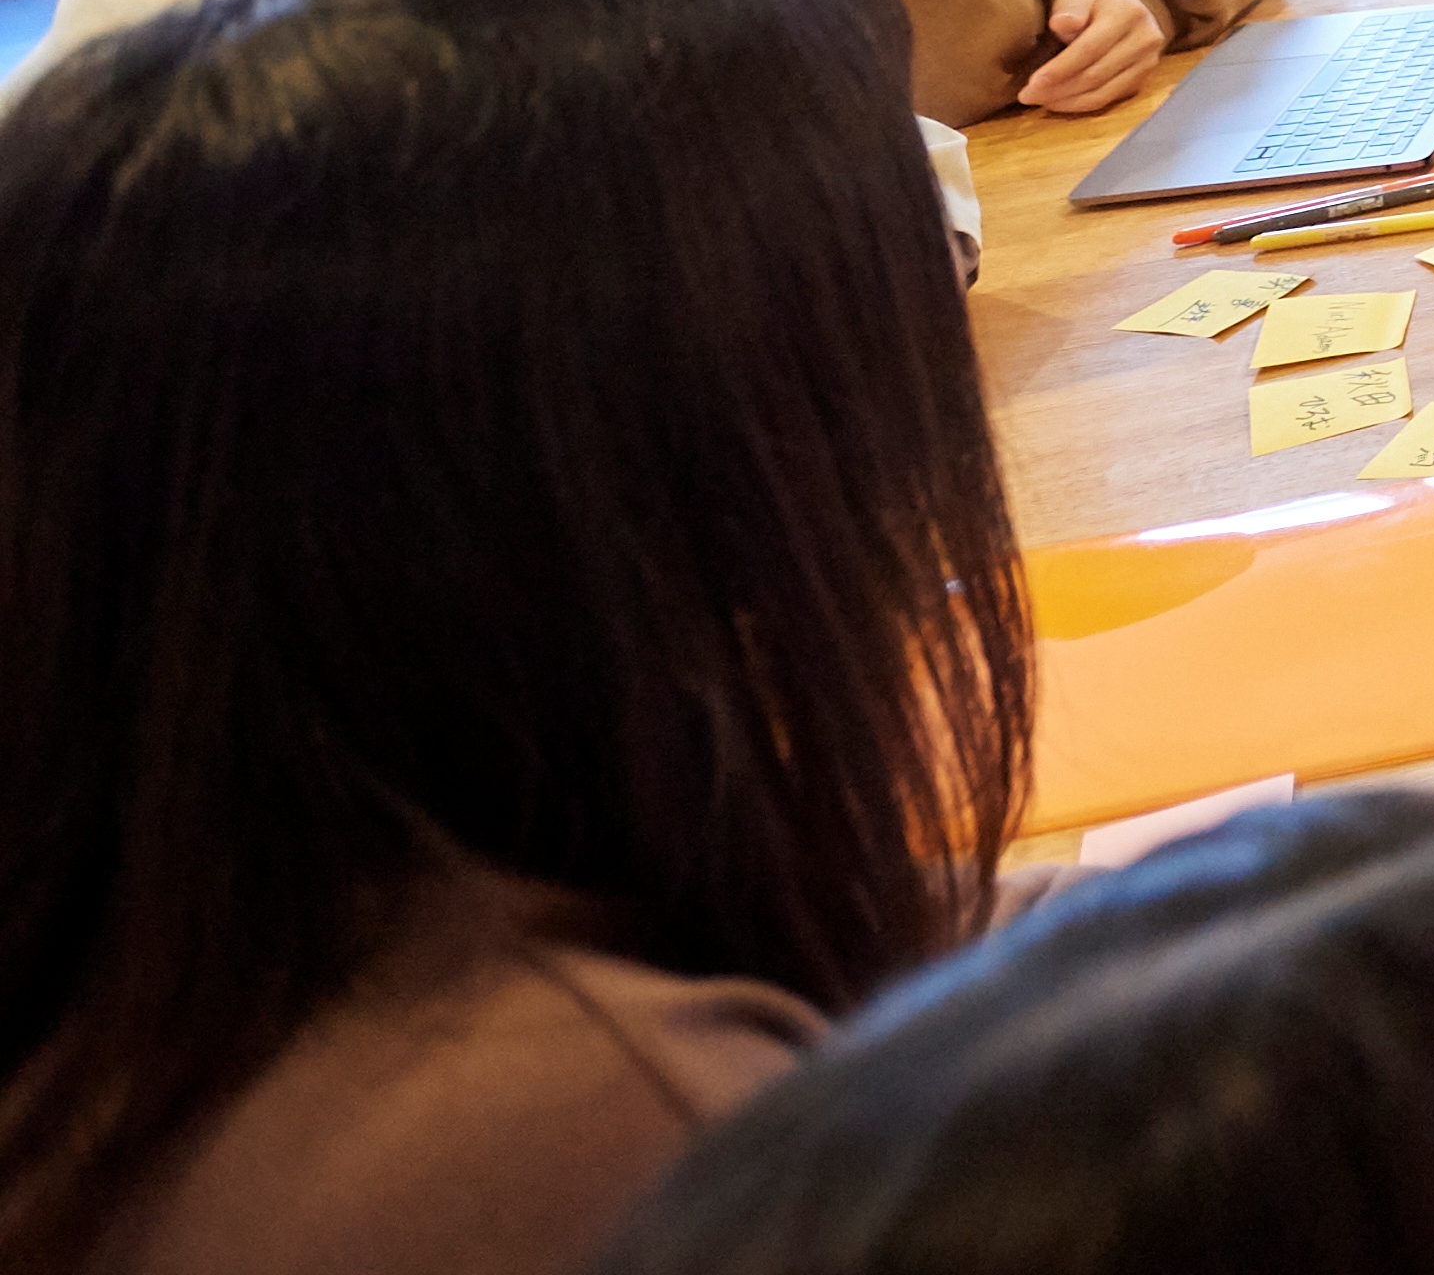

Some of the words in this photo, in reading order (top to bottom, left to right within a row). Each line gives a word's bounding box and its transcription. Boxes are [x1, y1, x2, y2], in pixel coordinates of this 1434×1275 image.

[1343, 368, 1397, 408] 秋田
[1295, 394, 1338, 432] ひろむ
